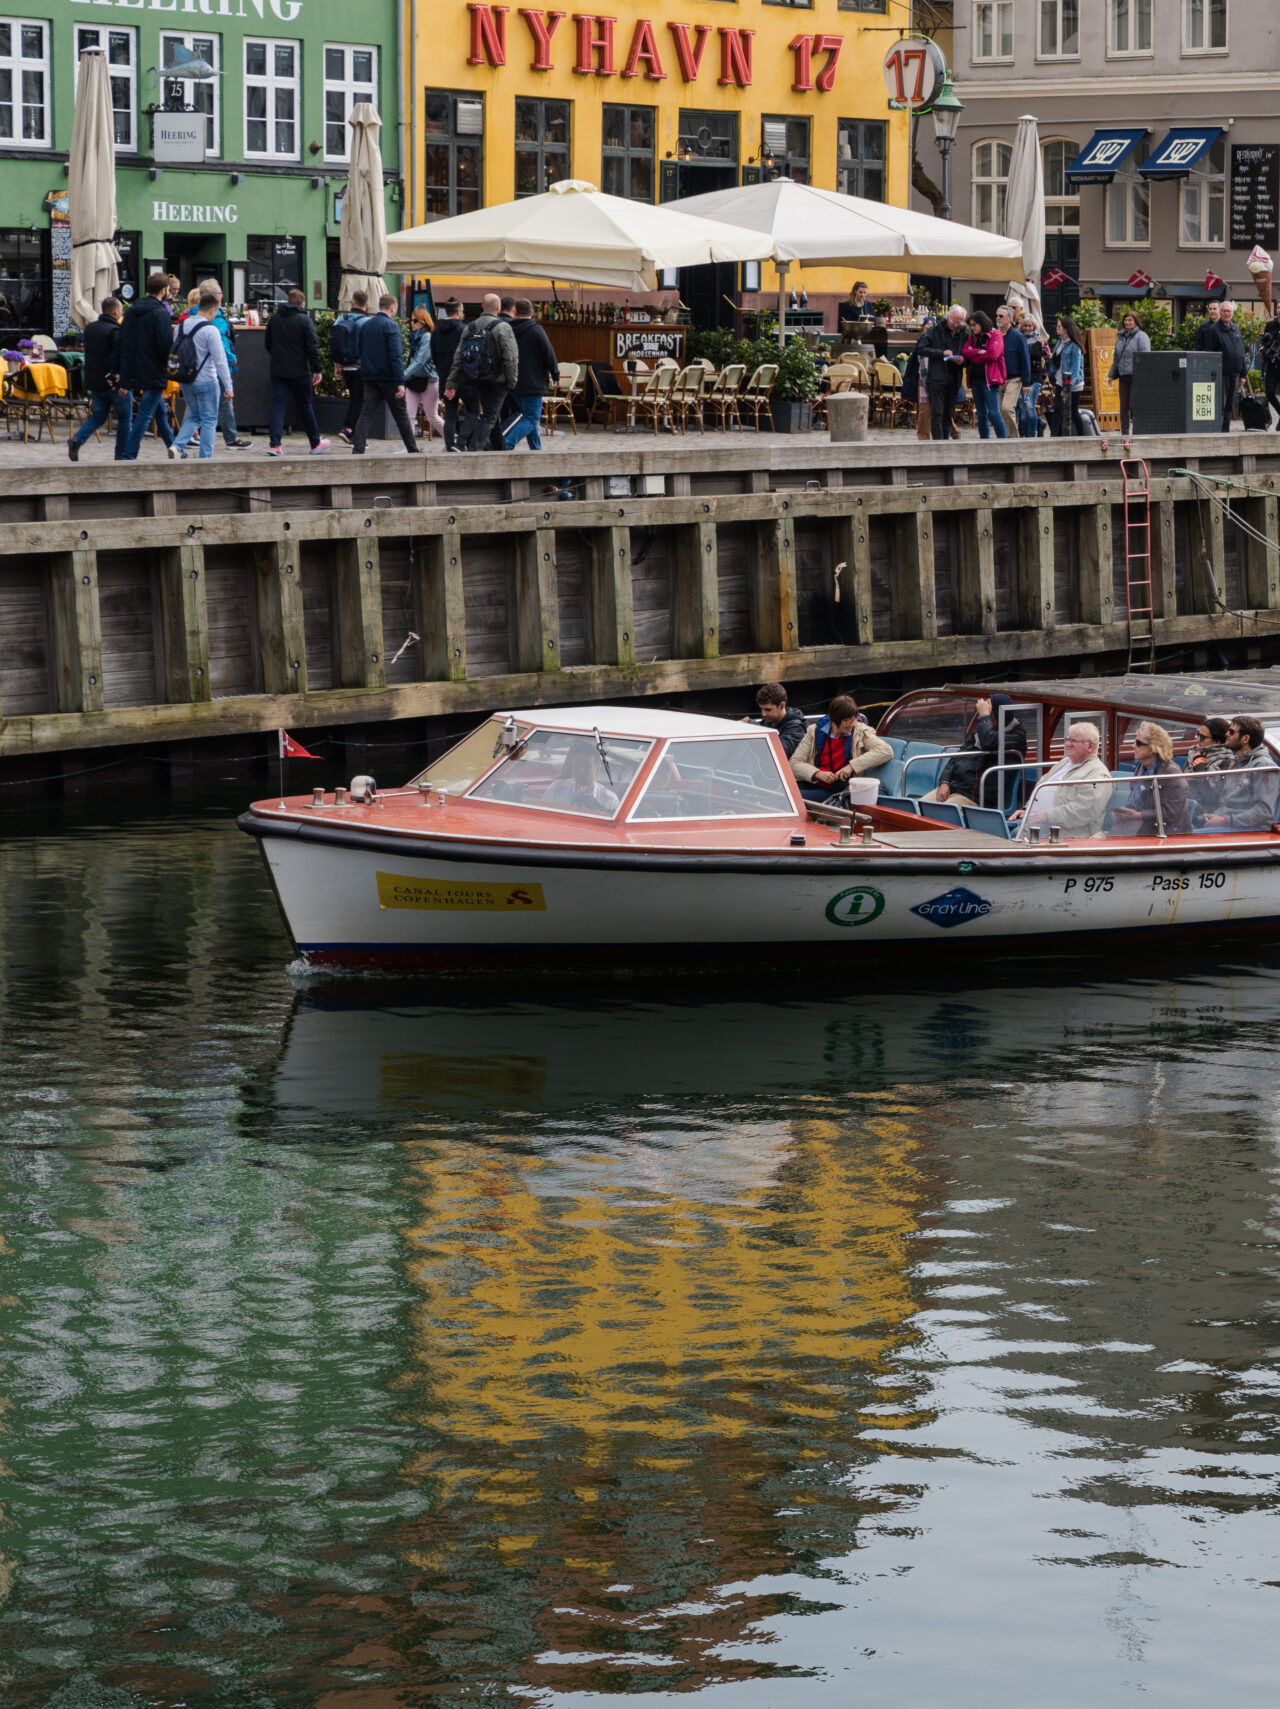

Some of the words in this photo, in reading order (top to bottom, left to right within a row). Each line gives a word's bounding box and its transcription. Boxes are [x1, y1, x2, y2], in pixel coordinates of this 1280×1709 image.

[466, 3, 756, 87] NYHAVN
[788, 34, 845, 92] 17
[886, 50, 927, 101] 17
[170, 84, 182, 96] 15
[160, 130, 197, 140] HEERING
[152, 201, 238, 223] HEERING
[616, 333, 683, 358] BREAKFAST
[1195, 394, 1212, 404] REN
[1195, 407, 1212, 417] KBH
[1064, 878, 1077, 893] P
[1083, 876, 1115, 893] 975
[1151, 875, 1190, 891] Pass
[1198, 871, 1226, 889] 150
[393, 885, 441, 896] CANAL
[447, 889, 492, 898] TOURS
[393, 894, 495, 905] COPENHAGEN
